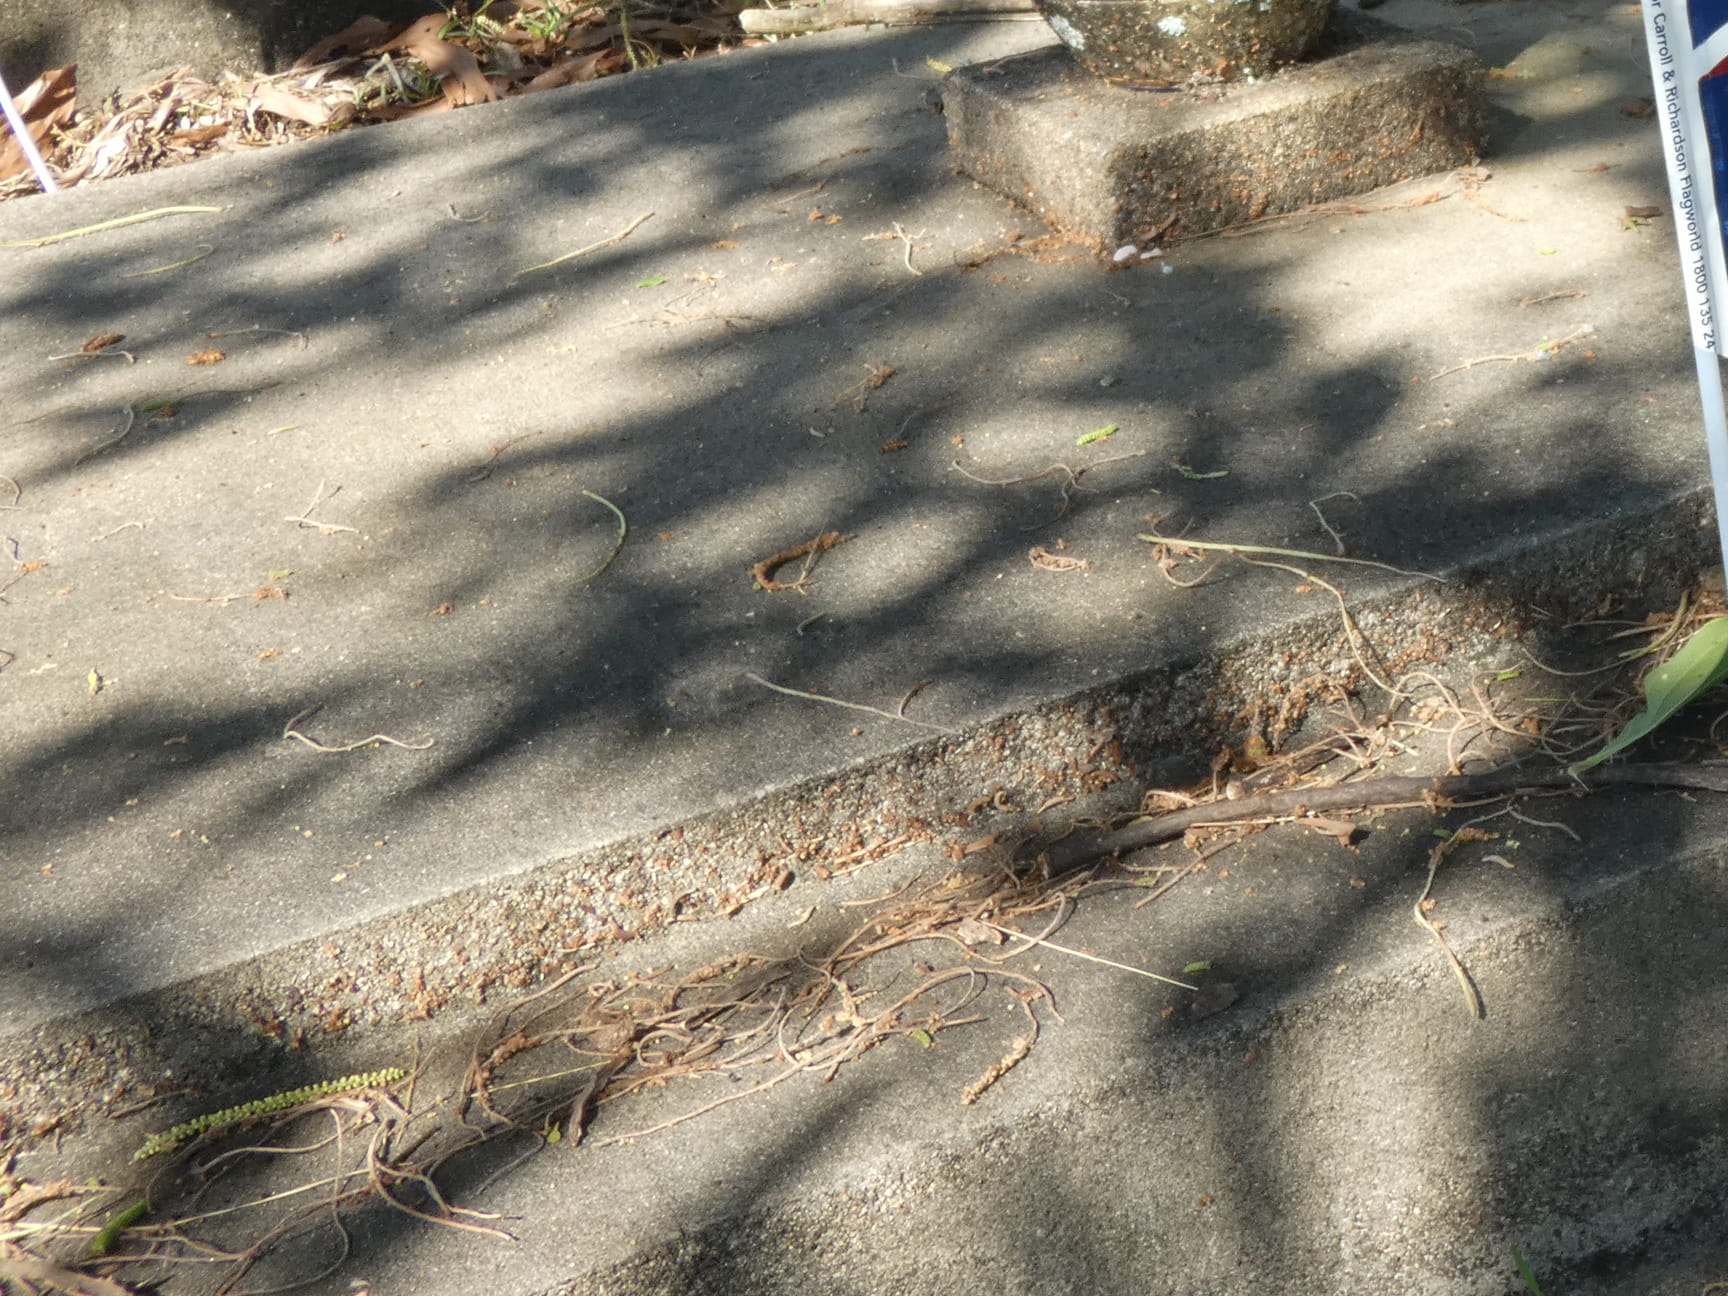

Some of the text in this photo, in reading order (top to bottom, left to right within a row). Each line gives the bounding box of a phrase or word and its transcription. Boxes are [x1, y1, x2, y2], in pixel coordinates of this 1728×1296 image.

[1653, 12, 1673, 65] Carroll
[1662, 70, 1675, 82] &
[1665, 86, 1687, 172] Richardson
[1680, 174, 1702, 253] Flagworld
[1693, 255, 1708, 294] 1800
[1699, 297, 1713, 326] 135
